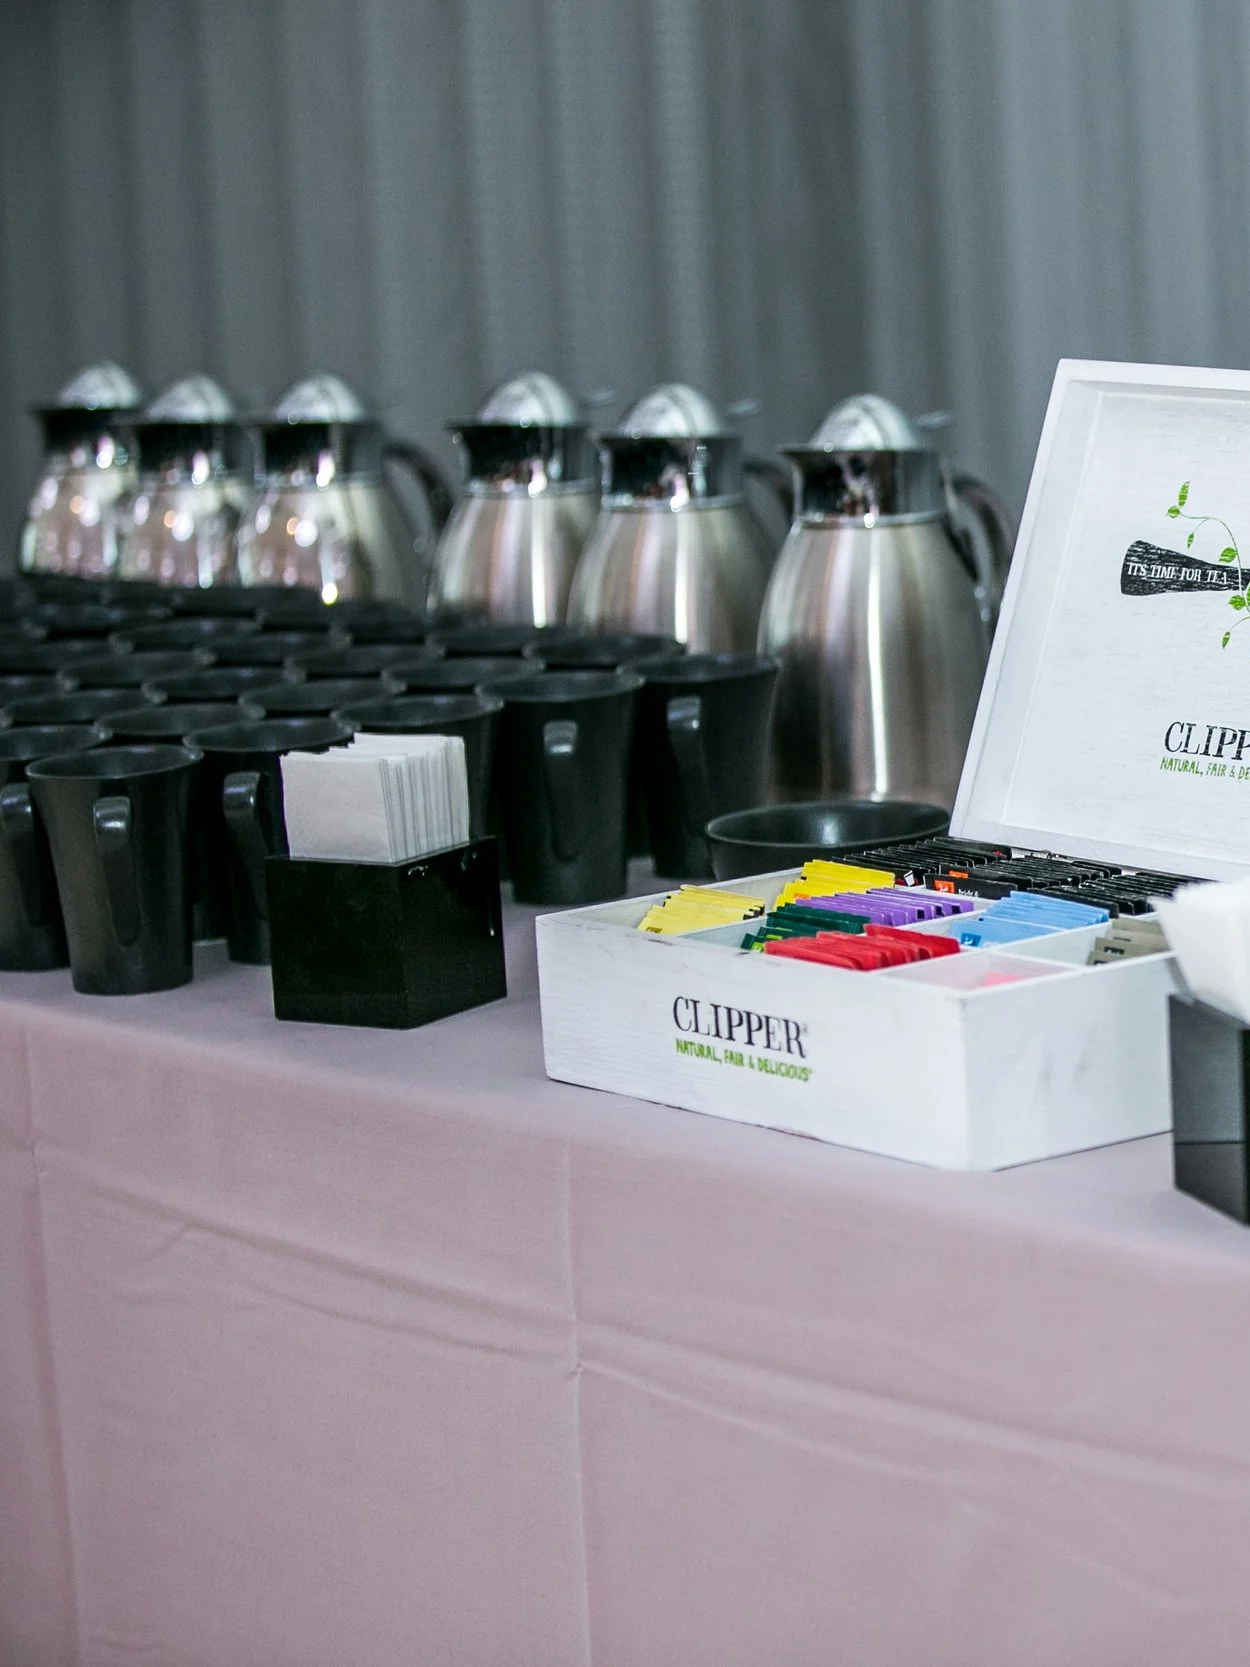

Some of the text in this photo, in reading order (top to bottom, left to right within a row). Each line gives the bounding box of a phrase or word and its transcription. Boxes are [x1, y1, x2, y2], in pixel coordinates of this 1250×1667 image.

[1150, 565, 1179, 580] TIME
[1180, 567, 1201, 581] FOR
[1206, 569, 1228, 585] TEA
[1160, 756, 1204, 777] NATURAL,
[1206, 762, 1226, 777] FAIR
[1229, 765, 1236, 779] &
[675, 1037, 811, 1082] NATURAL, FAIR & DELICIOUS
